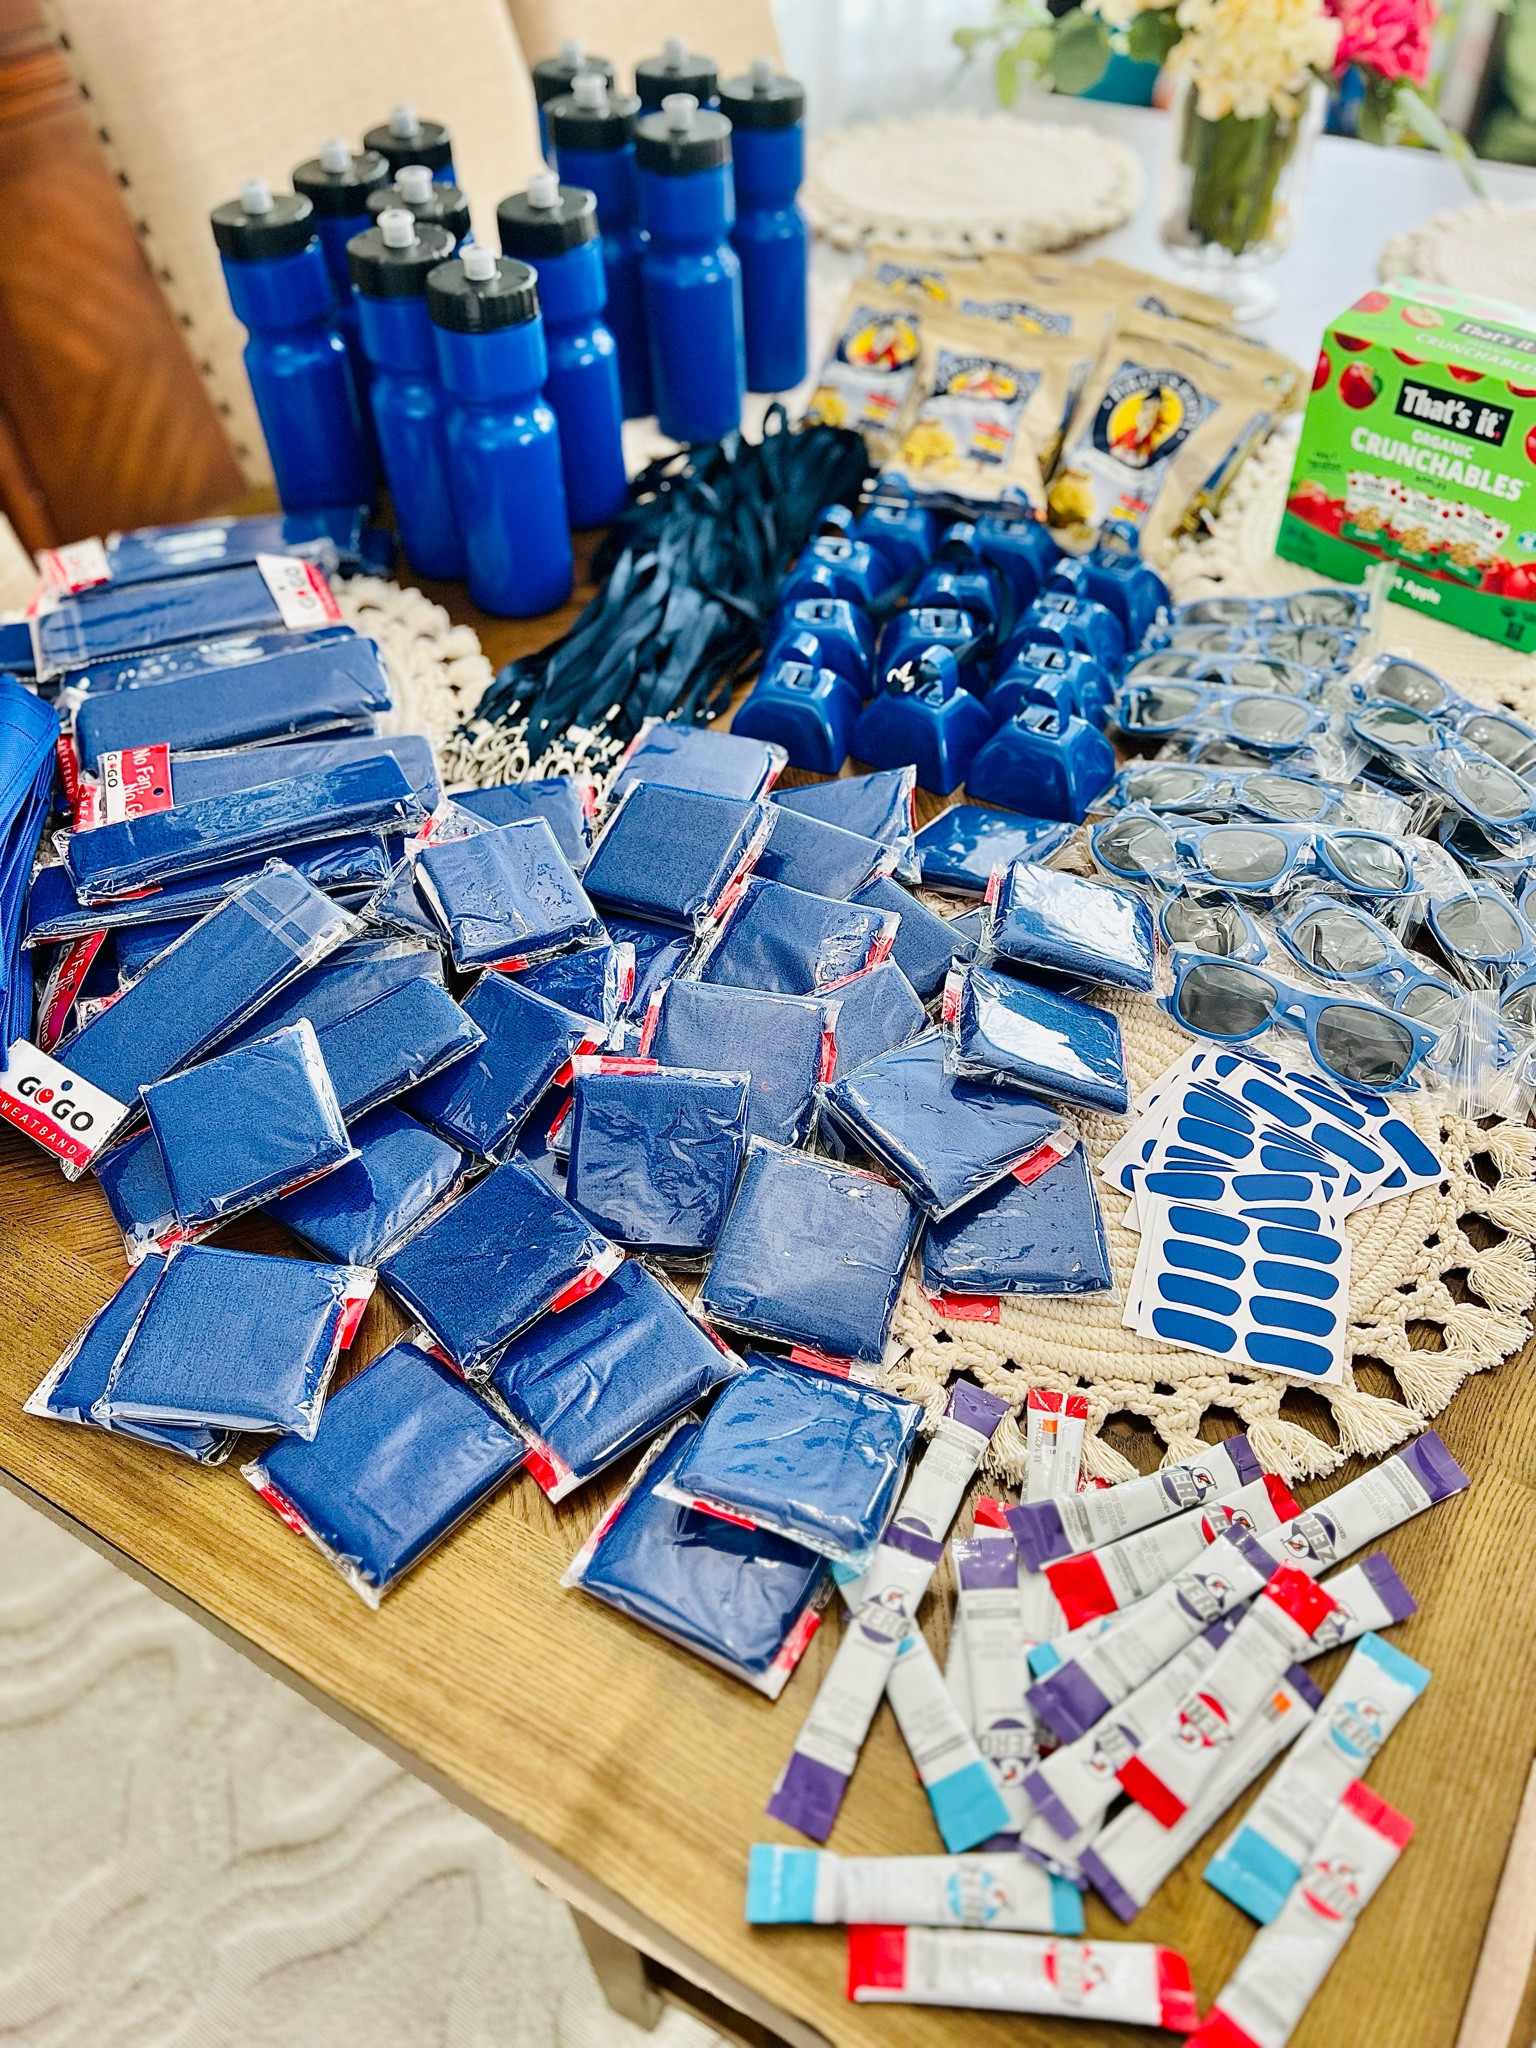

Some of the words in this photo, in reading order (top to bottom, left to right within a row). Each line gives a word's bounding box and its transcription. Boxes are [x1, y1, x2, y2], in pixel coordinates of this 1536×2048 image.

[1402, 385, 1473, 429] That's
[1411, 429, 1475, 459] ORGANIC
[1350, 426, 1524, 502] CRUNCHABLES
[132, 747, 151, 766] No
[123, 782, 139, 803] No
[75, 937, 94, 958] No
[0, 1095, 77, 1155] WEATBAND
